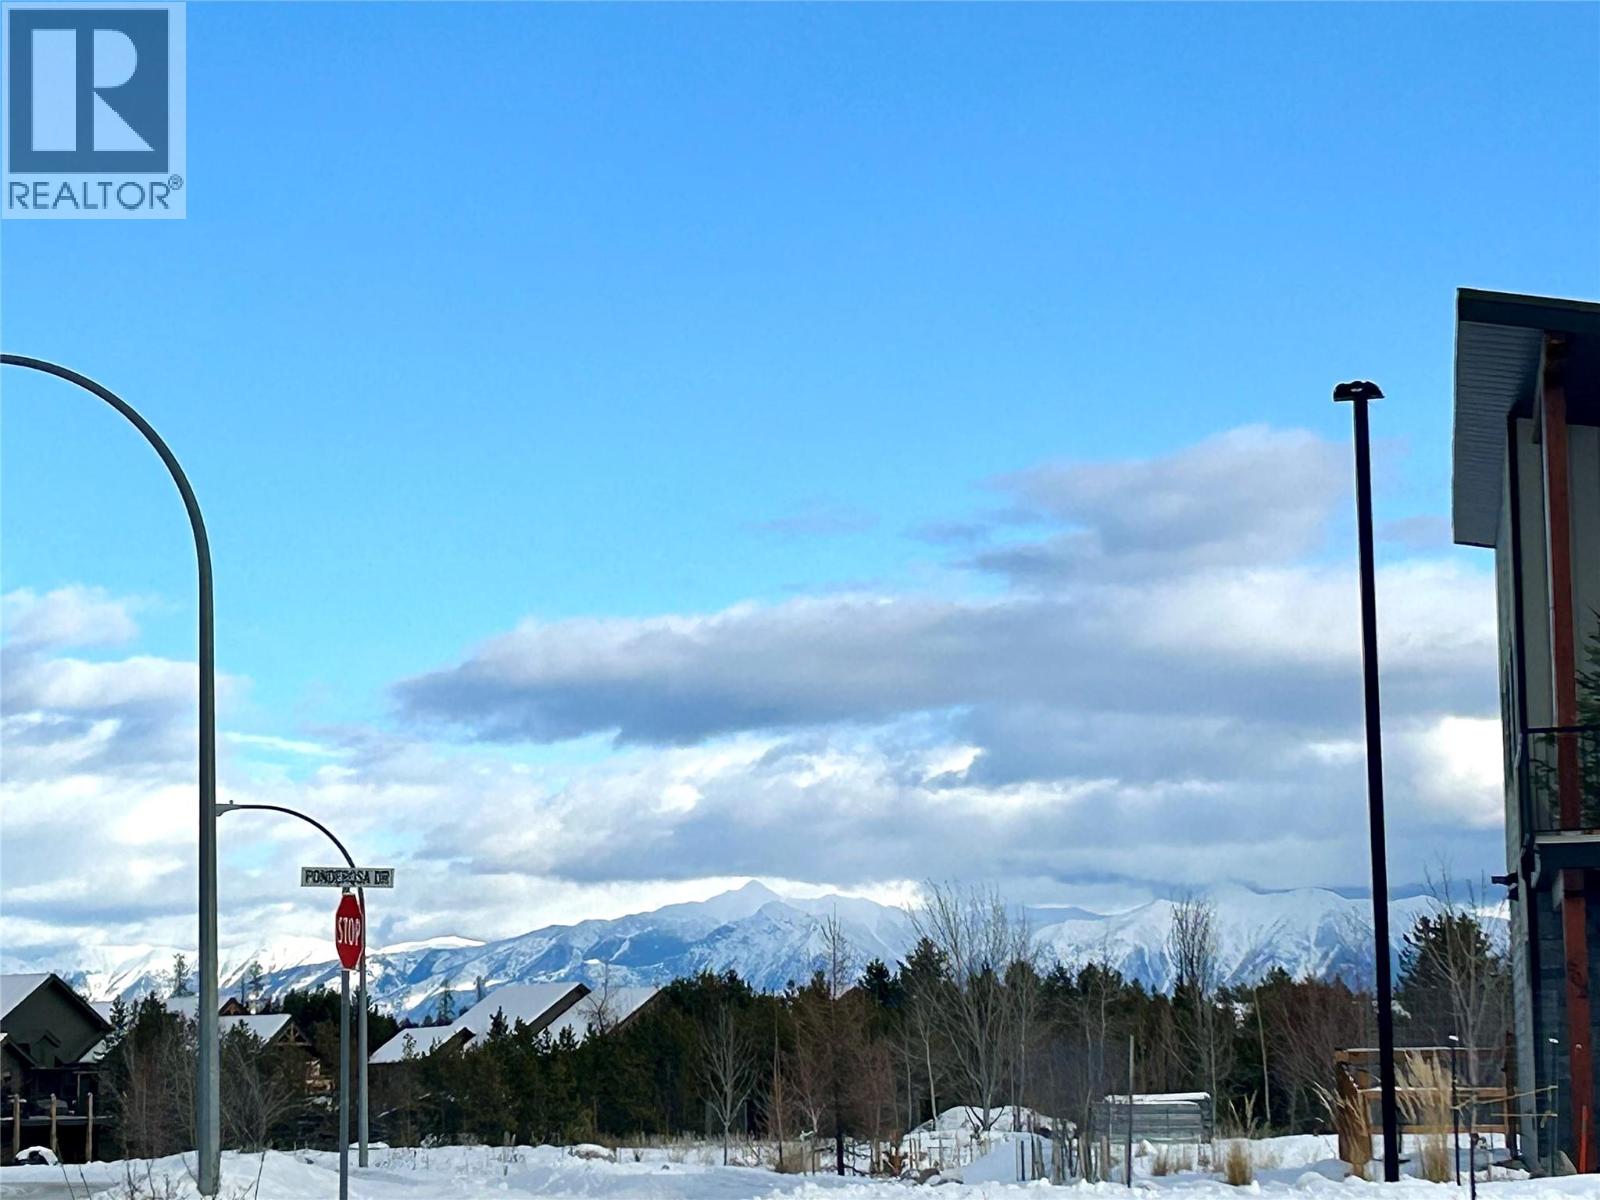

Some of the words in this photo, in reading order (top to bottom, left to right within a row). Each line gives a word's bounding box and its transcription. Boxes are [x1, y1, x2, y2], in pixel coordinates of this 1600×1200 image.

[305, 870, 370, 884] PONDEROSA
[374, 870, 390, 884] DR
[337, 917, 361, 946] STOP
